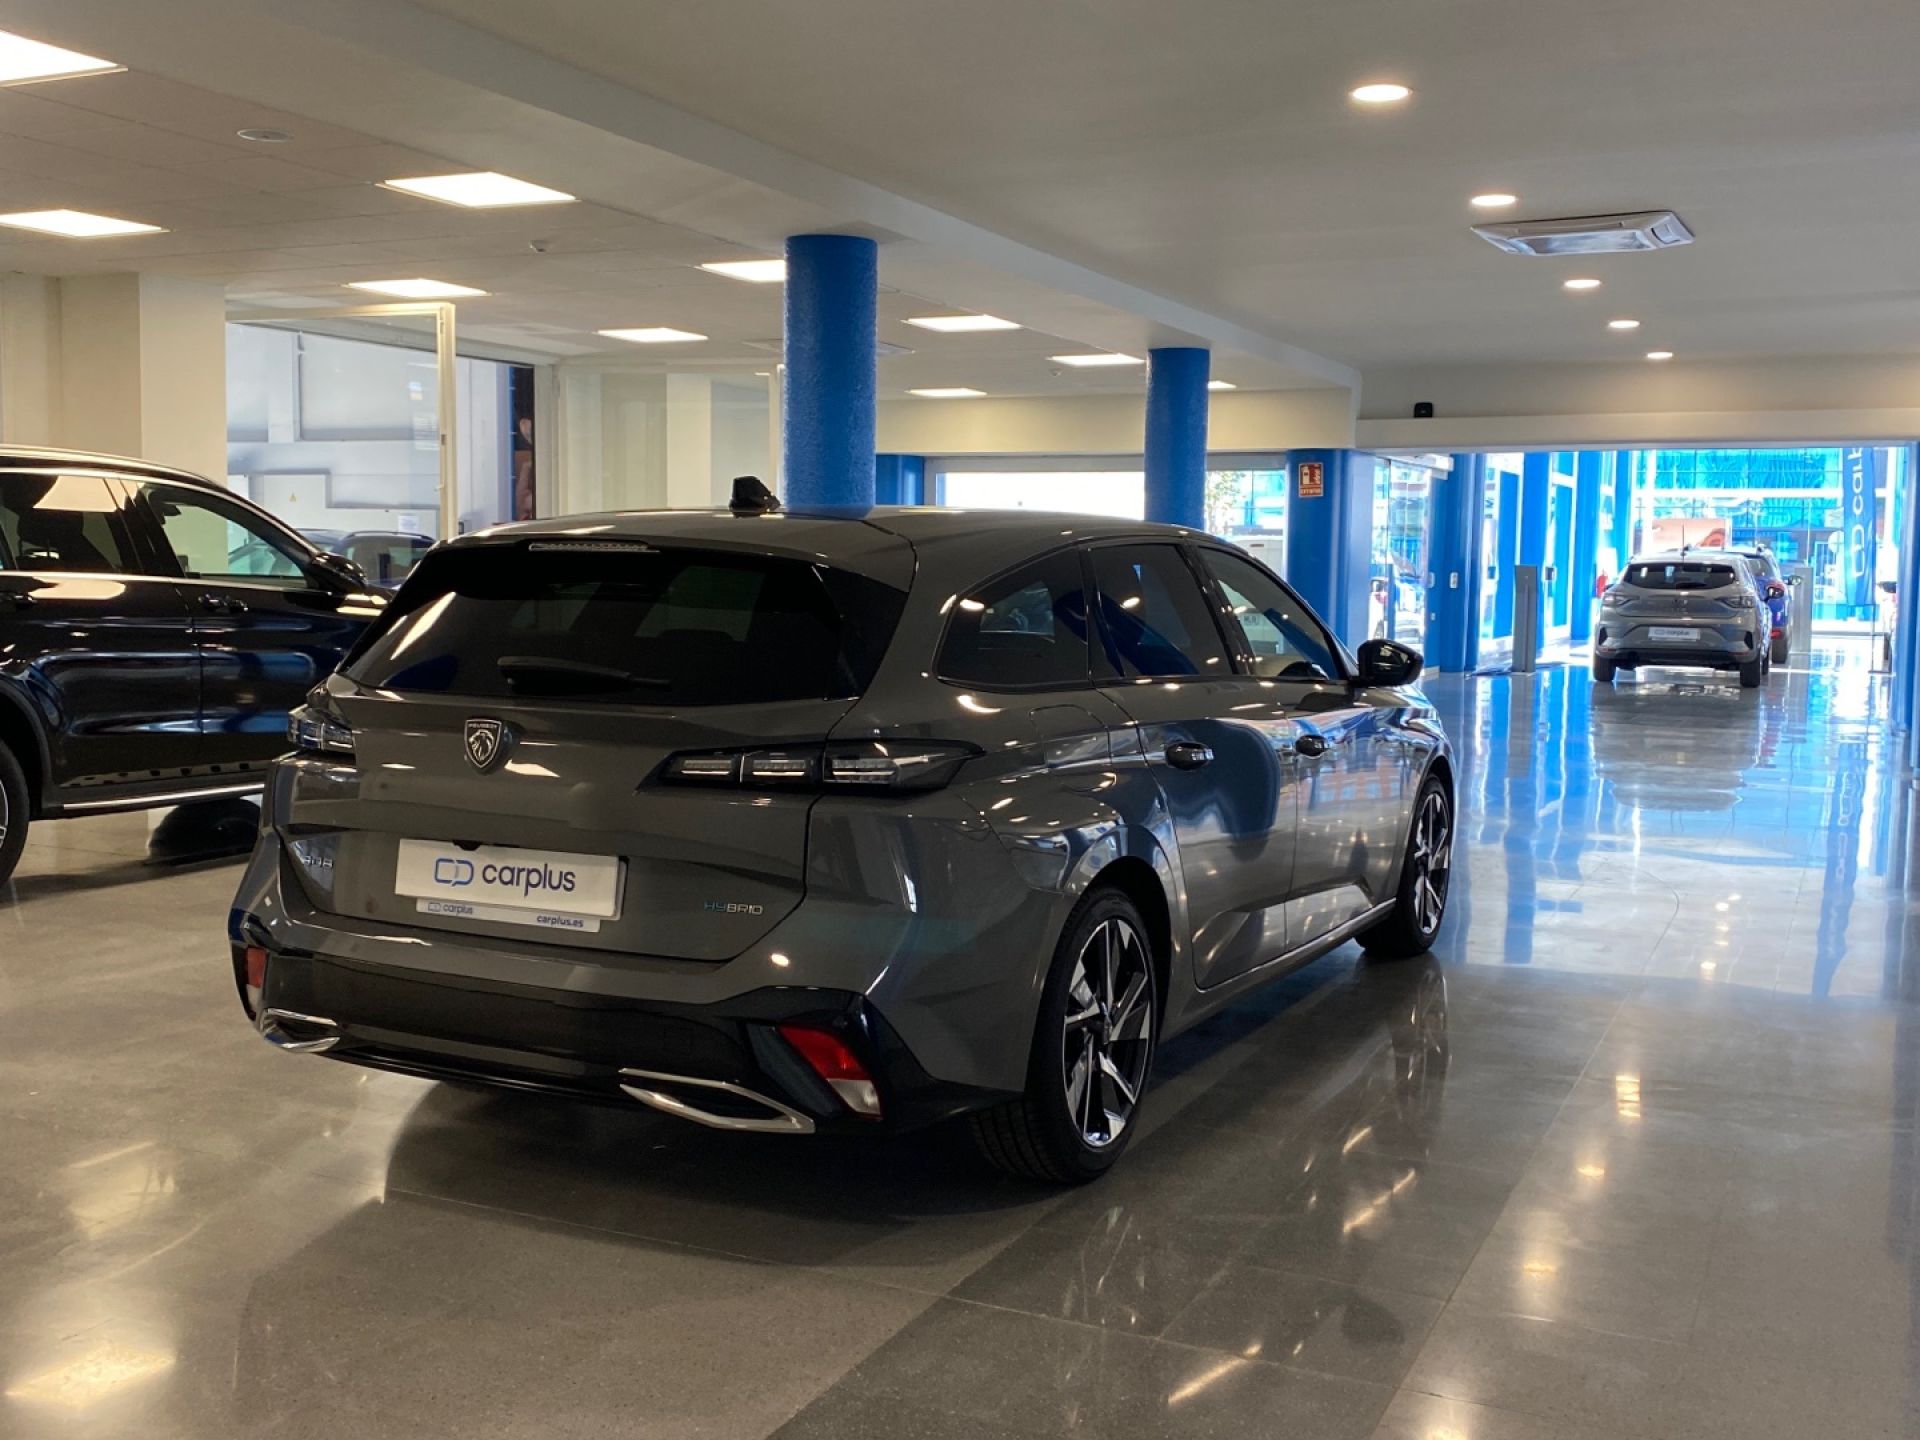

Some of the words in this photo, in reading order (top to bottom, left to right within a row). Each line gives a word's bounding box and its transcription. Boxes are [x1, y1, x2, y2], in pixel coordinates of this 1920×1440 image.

[482, 863, 576, 897] carplus
[442, 902, 474, 915] carplus
[703, 901, 764, 916] HYBRID
[536, 915, 584, 928] carplus.es
